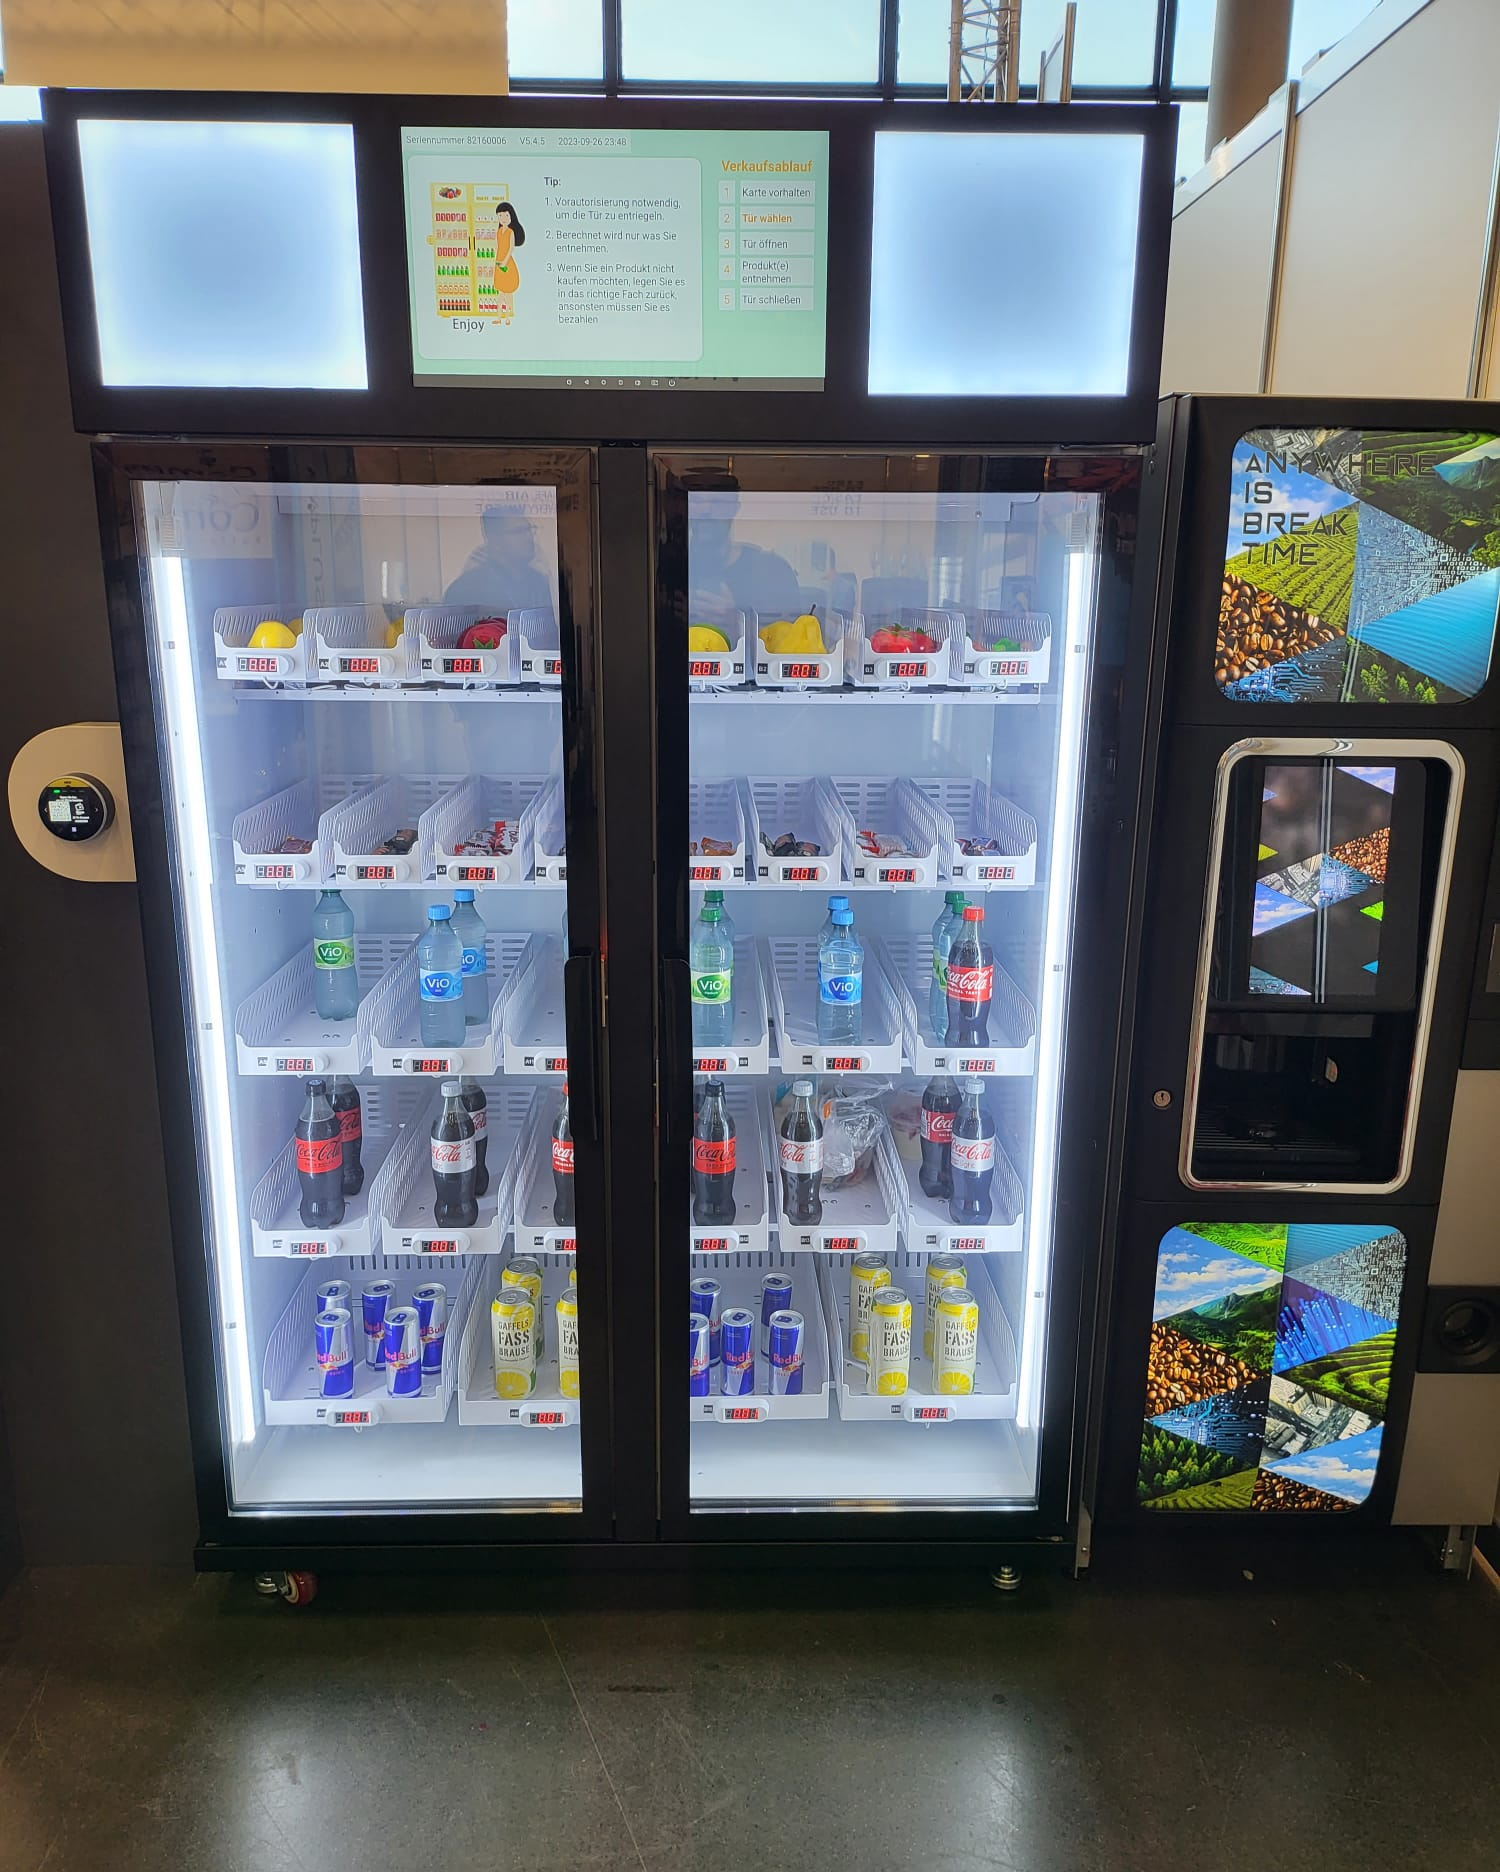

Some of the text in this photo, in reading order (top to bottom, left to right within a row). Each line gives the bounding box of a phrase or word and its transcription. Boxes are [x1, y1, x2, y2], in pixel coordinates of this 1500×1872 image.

[406, 135, 507, 145] Seriennummer 82160006
[519, 137, 546, 146] V5.4.5
[558, 137, 627, 146] 2023-09-26 23:48
[721, 160, 813, 173] Verkaufsablauf
[544, 176, 561, 188] Tip:
[742, 187, 811, 198] Karte vorhalten
[555, 197, 630, 210] Vorautorisierung
[632, 198, 681, 210] notwendig,
[555, 210, 665, 222] um die Tür zu entriegeln.
[724, 213, 730, 223] 2
[742, 213, 792, 223] Tür wählen
[545, 230, 677, 241] 2. Berechnet wird nur was Sie
[556, 244, 609, 253] entnehmen.
[724, 239, 730, 249] 3
[742, 239, 788, 249] Tür öffnen
[546, 263, 675, 274] 3. Wenn Sie ein Produkt nicht
[742, 260, 789, 273] Produkt(e)
[557, 275, 588, 286] kaufen
[633, 277, 657, 288] legen
[659, 277, 673, 287] Sie
[675, 279, 686, 287] es
[742, 274, 792, 284] entnehmen
[557, 289, 678, 301] in das richtige Fach zurück,
[724, 294, 730, 304] 5
[758, 294, 801, 305] schließen
[558, 302, 671, 312] ansonsten müssen Sie es
[558, 314, 599, 324] bezahlen
[452, 318, 485, 333] Enjoy
[1245, 452, 1440, 478] ANYWHERE
[1244, 481, 1273, 504] IS
[1242, 512, 1348, 536] BREAK
[1242, 542, 1319, 566] TIME
[498, 1330, 530, 1347] FASS
[945, 1331, 976, 1346] FASS
[498, 1346, 530, 1357] BRAUSE
